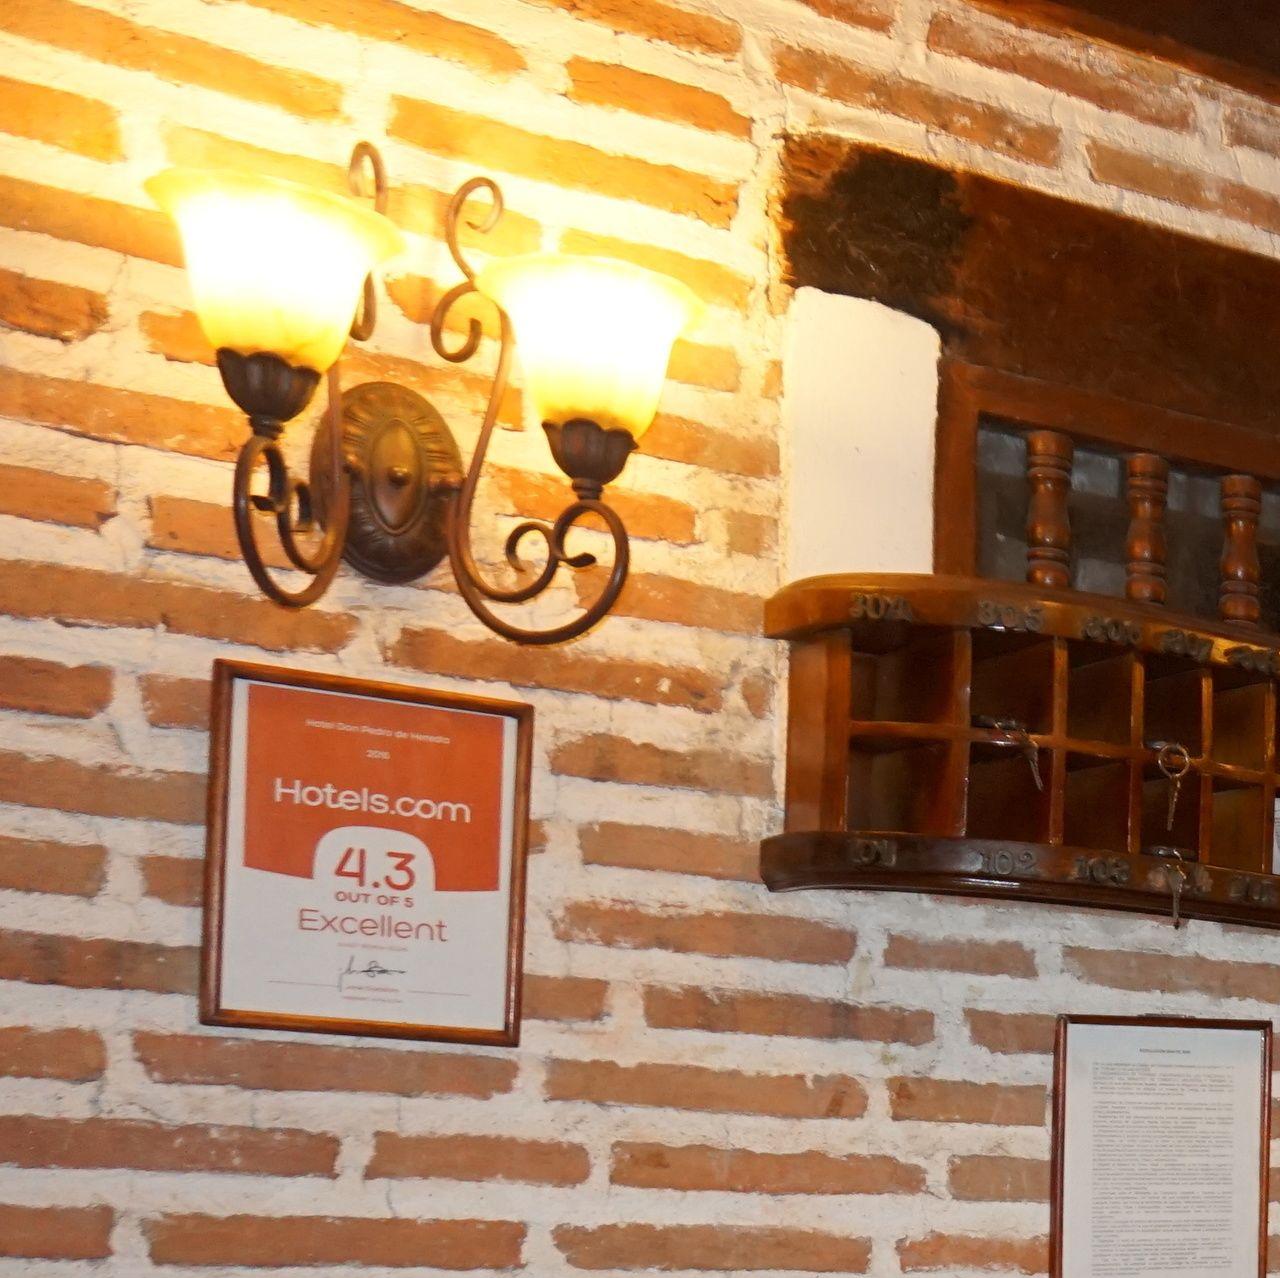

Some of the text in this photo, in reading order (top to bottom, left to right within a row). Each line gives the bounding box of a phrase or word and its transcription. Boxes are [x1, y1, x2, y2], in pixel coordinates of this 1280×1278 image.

[274, 777, 471, 823] Hotels.com
[335, 847, 416, 891] 4.3
[335, 891, 414, 908] OUT OF 5
[298, 908, 448, 942] Excellent
